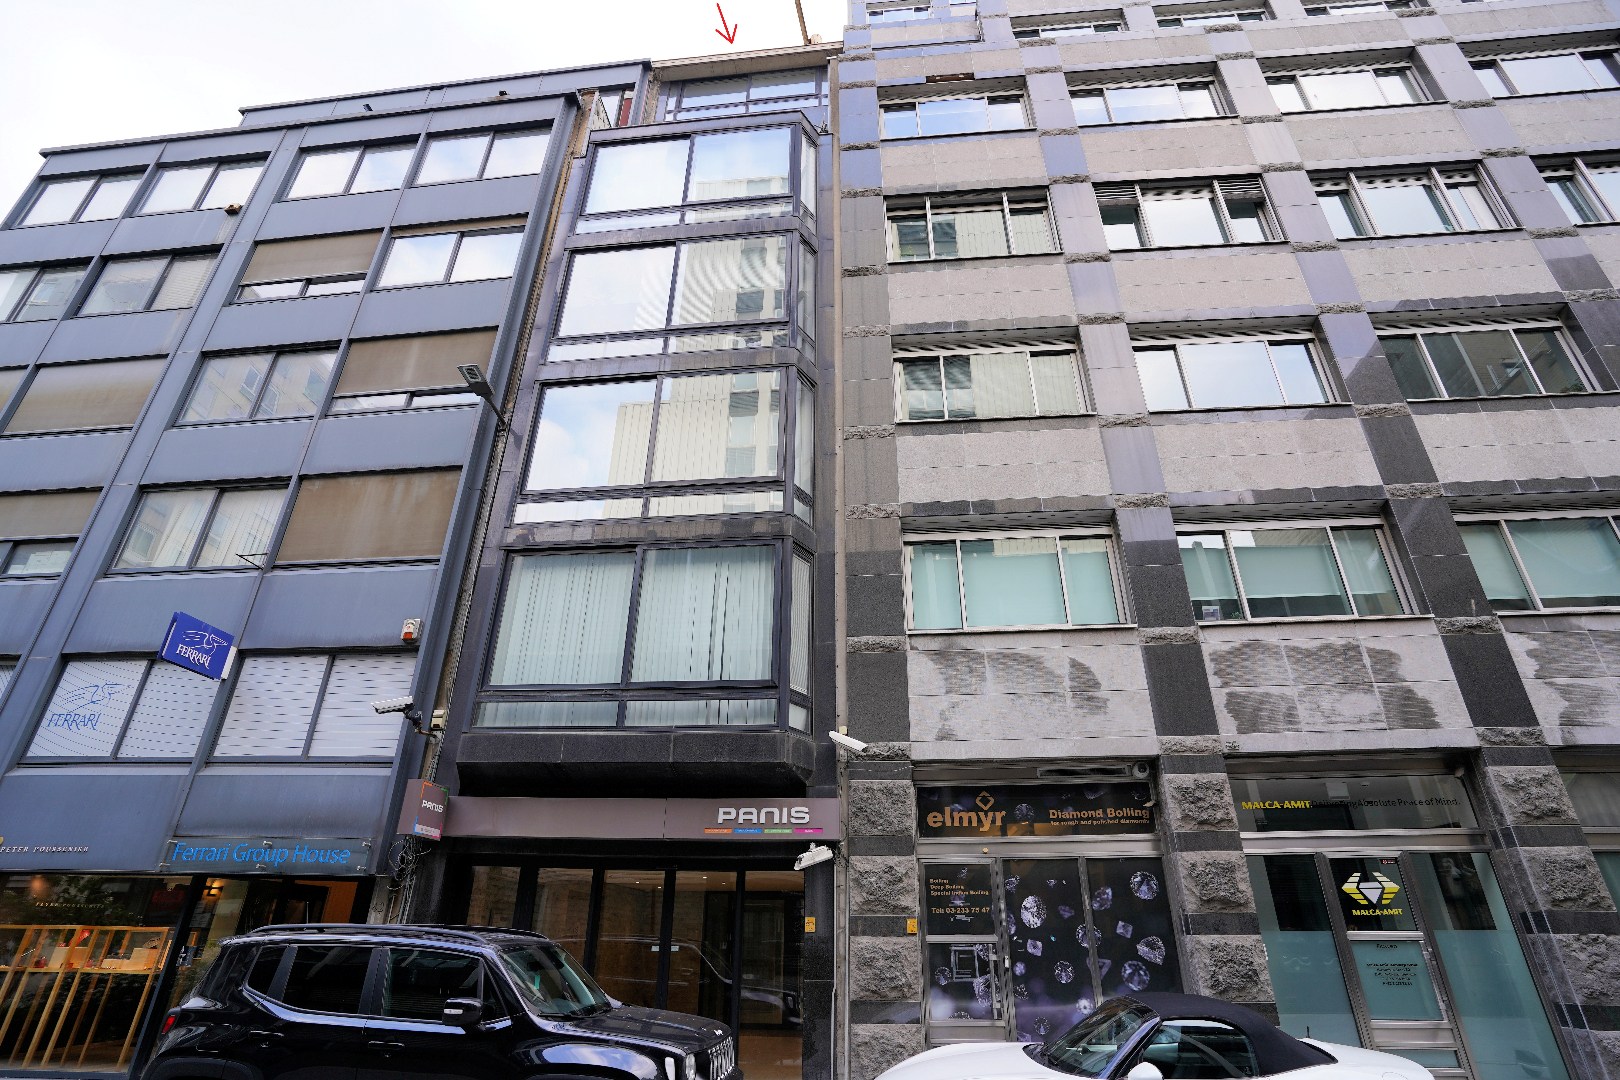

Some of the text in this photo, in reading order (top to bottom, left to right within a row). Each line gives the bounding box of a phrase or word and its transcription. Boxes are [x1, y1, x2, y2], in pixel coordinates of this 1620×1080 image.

[176, 644, 211, 669] FERRARI
[47, 713, 101, 731] FERRARI
[421, 799, 444, 813] PANIS
[1358, 798, 1397, 807] Absolute
[1425, 797, 1435, 806] of
[718, 806, 810, 824] PANIS
[926, 806, 1007, 832] elmyr
[1049, 809, 1104, 819] Diamond
[172, 842, 351, 867] Ferrari Group House
[1352, 908, 1403, 916] MALCA-AMIT
